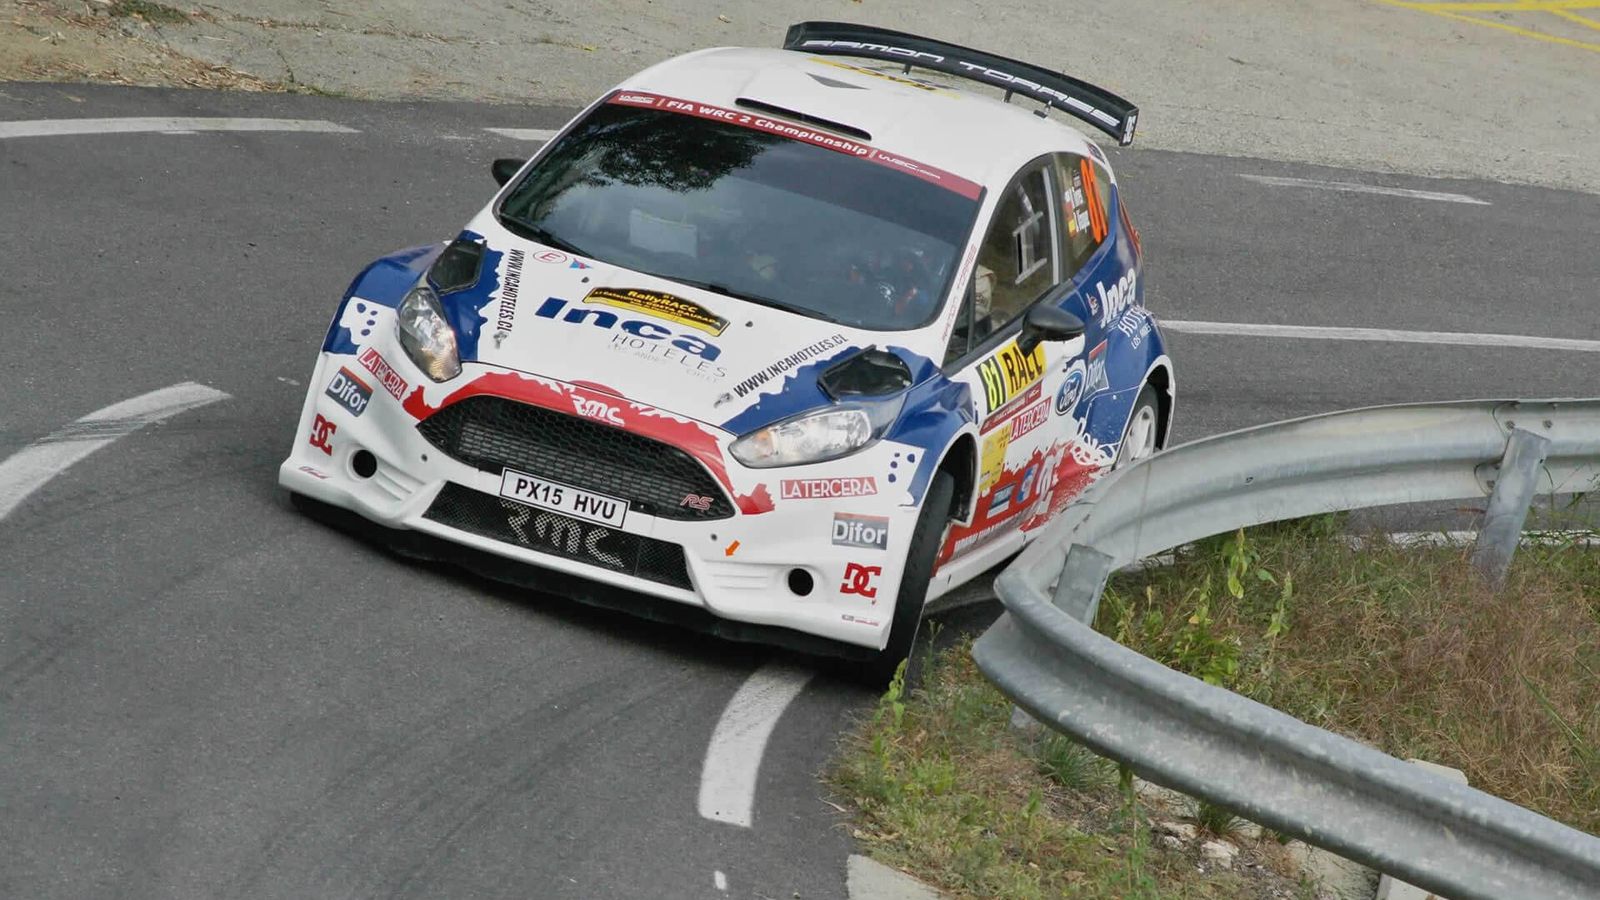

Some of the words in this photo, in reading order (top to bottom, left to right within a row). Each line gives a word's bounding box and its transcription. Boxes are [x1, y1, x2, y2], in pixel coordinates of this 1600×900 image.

[959, 61, 1121, 127] TORRES
[666, 99, 695, 112] FIA
[699, 106, 737, 120] WRC
[738, 116, 753, 124] 2
[754, 119, 868, 156] Championship
[497, 249, 525, 332] WWW.INCAHOTELES.CL
[627, 290, 699, 314] RallyRACC
[1096, 268, 1136, 329] Inca
[534, 297, 722, 362] Inca
[612, 333, 727, 378] HOTELES
[733, 333, 849, 398] WWW.INCAHOTELES.CL
[328, 372, 367, 412] Difor
[980, 358, 1004, 411] 81
[1059, 377, 1080, 407] Ford
[309, 413, 337, 456] DC
[514, 478, 564, 505] PX15
[574, 494, 616, 520] HVU
[680, 494, 714, 511] RS
[781, 478, 876, 498] LATERCERA
[833, 520, 886, 544] Difor
[840, 562, 882, 598] DC
